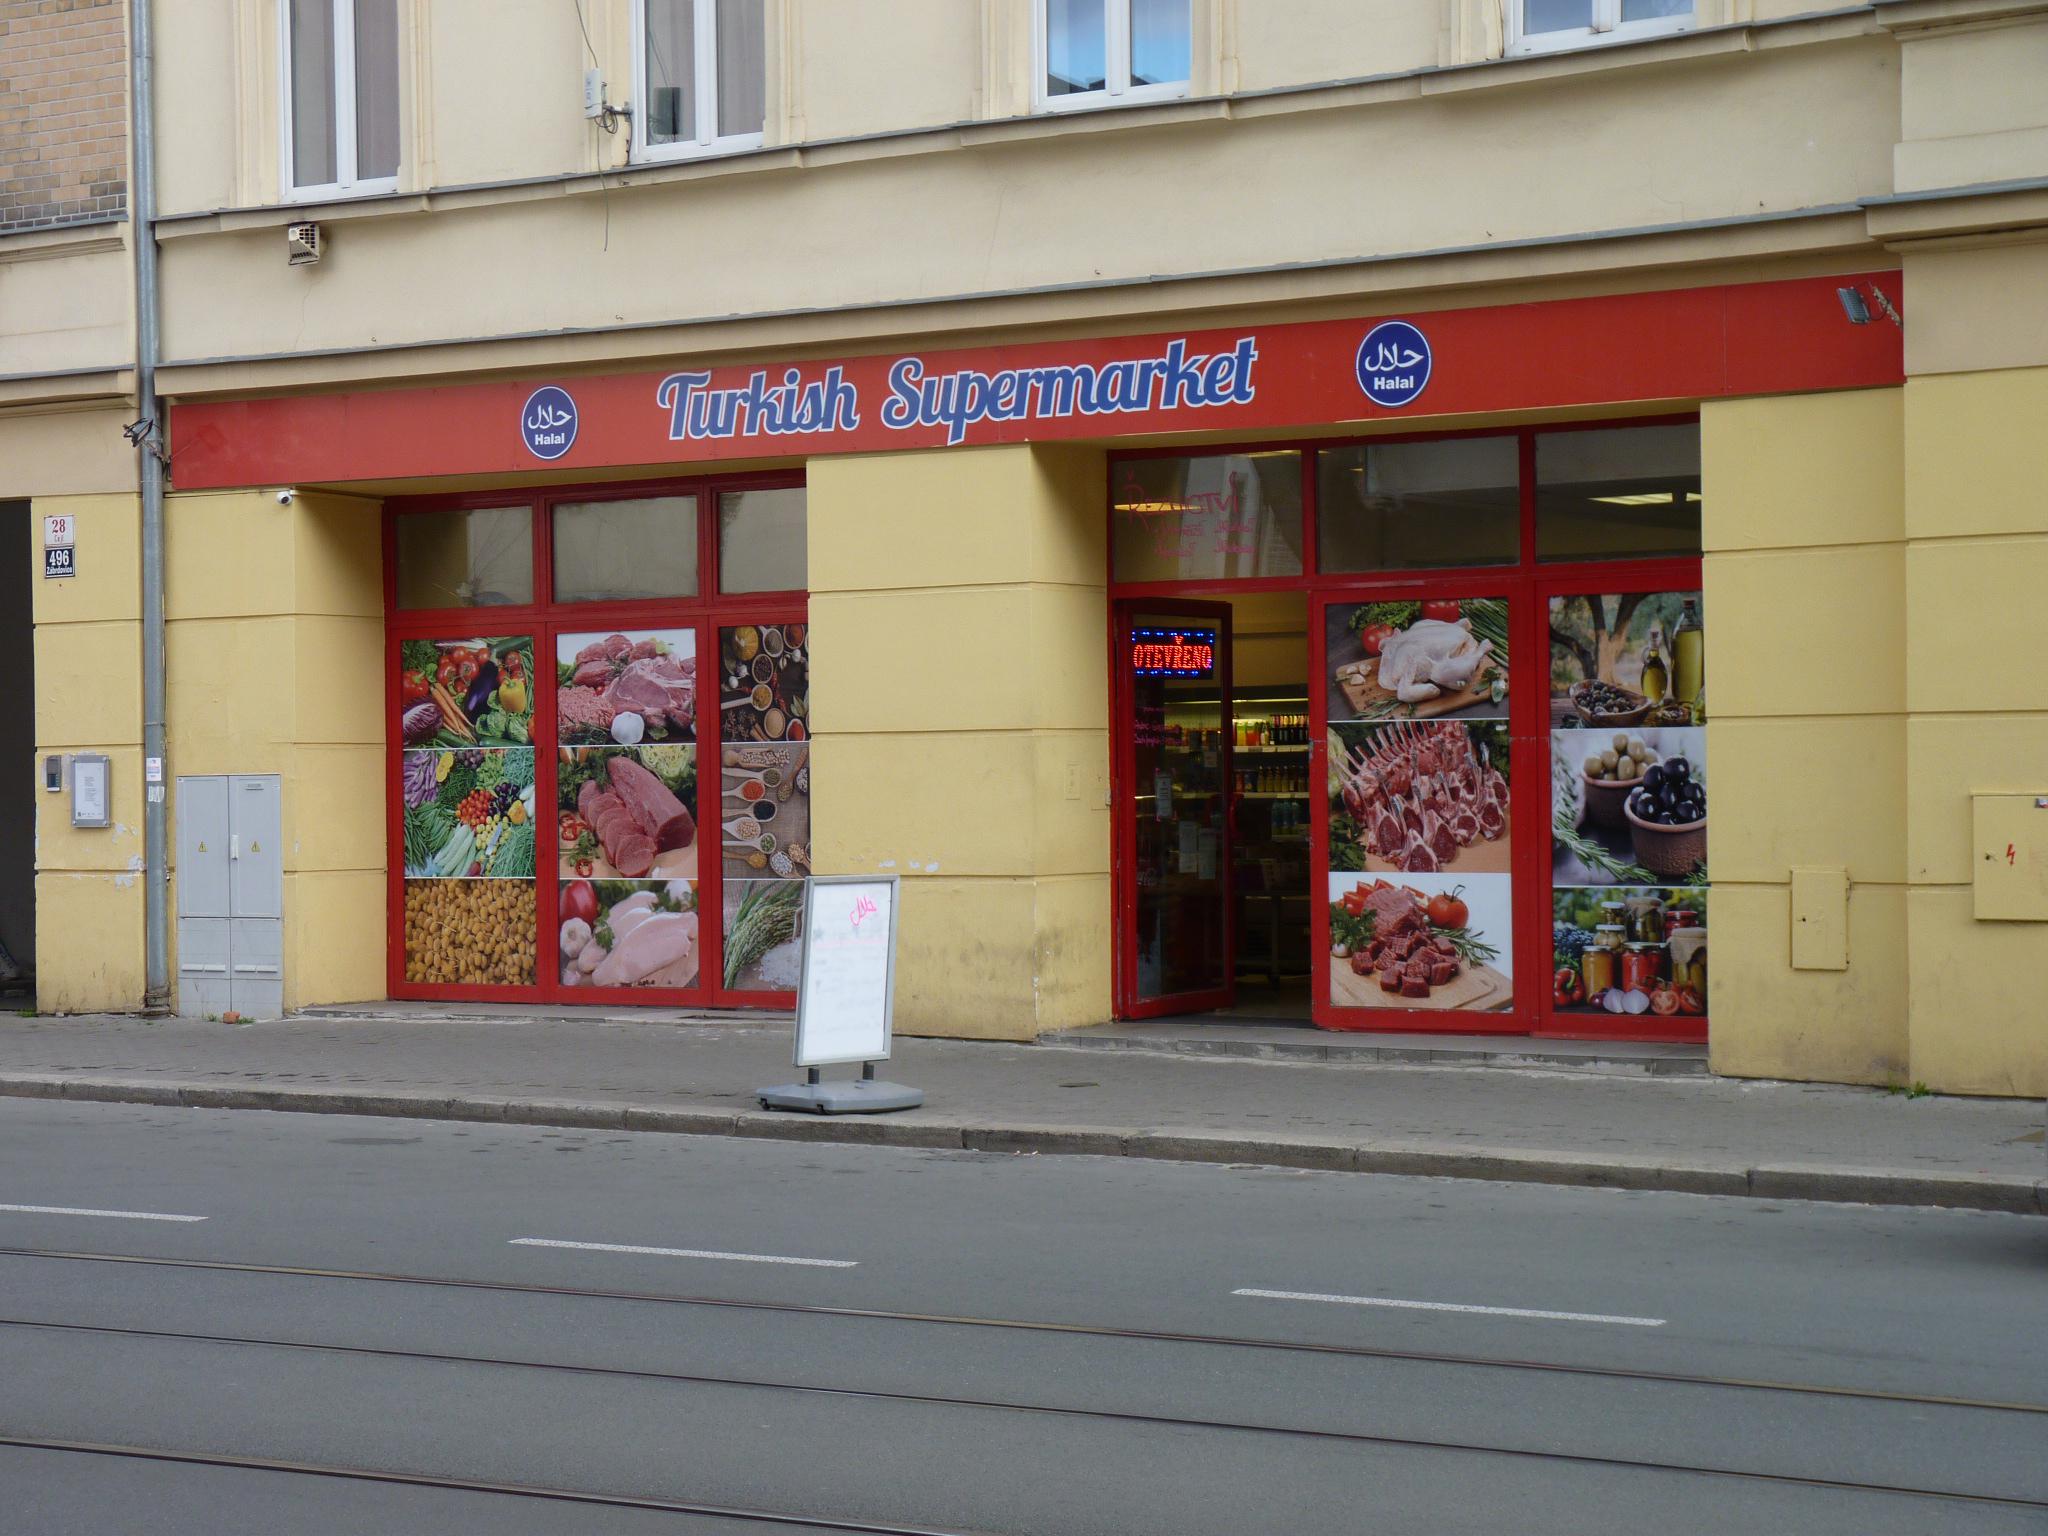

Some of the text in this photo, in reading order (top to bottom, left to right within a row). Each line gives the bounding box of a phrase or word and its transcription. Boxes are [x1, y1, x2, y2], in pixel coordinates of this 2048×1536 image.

[1364, 342, 1424, 372] حلال
[657, 336, 1258, 446] Turkish Supermarket
[1373, 375, 1414, 390] Halal
[527, 404, 573, 430] حلال
[534, 432, 565, 446] Halal
[52, 519, 66, 533] 28
[49, 550, 70, 566] 496
[1133, 635, 1212, 669] OTEVŘENO
